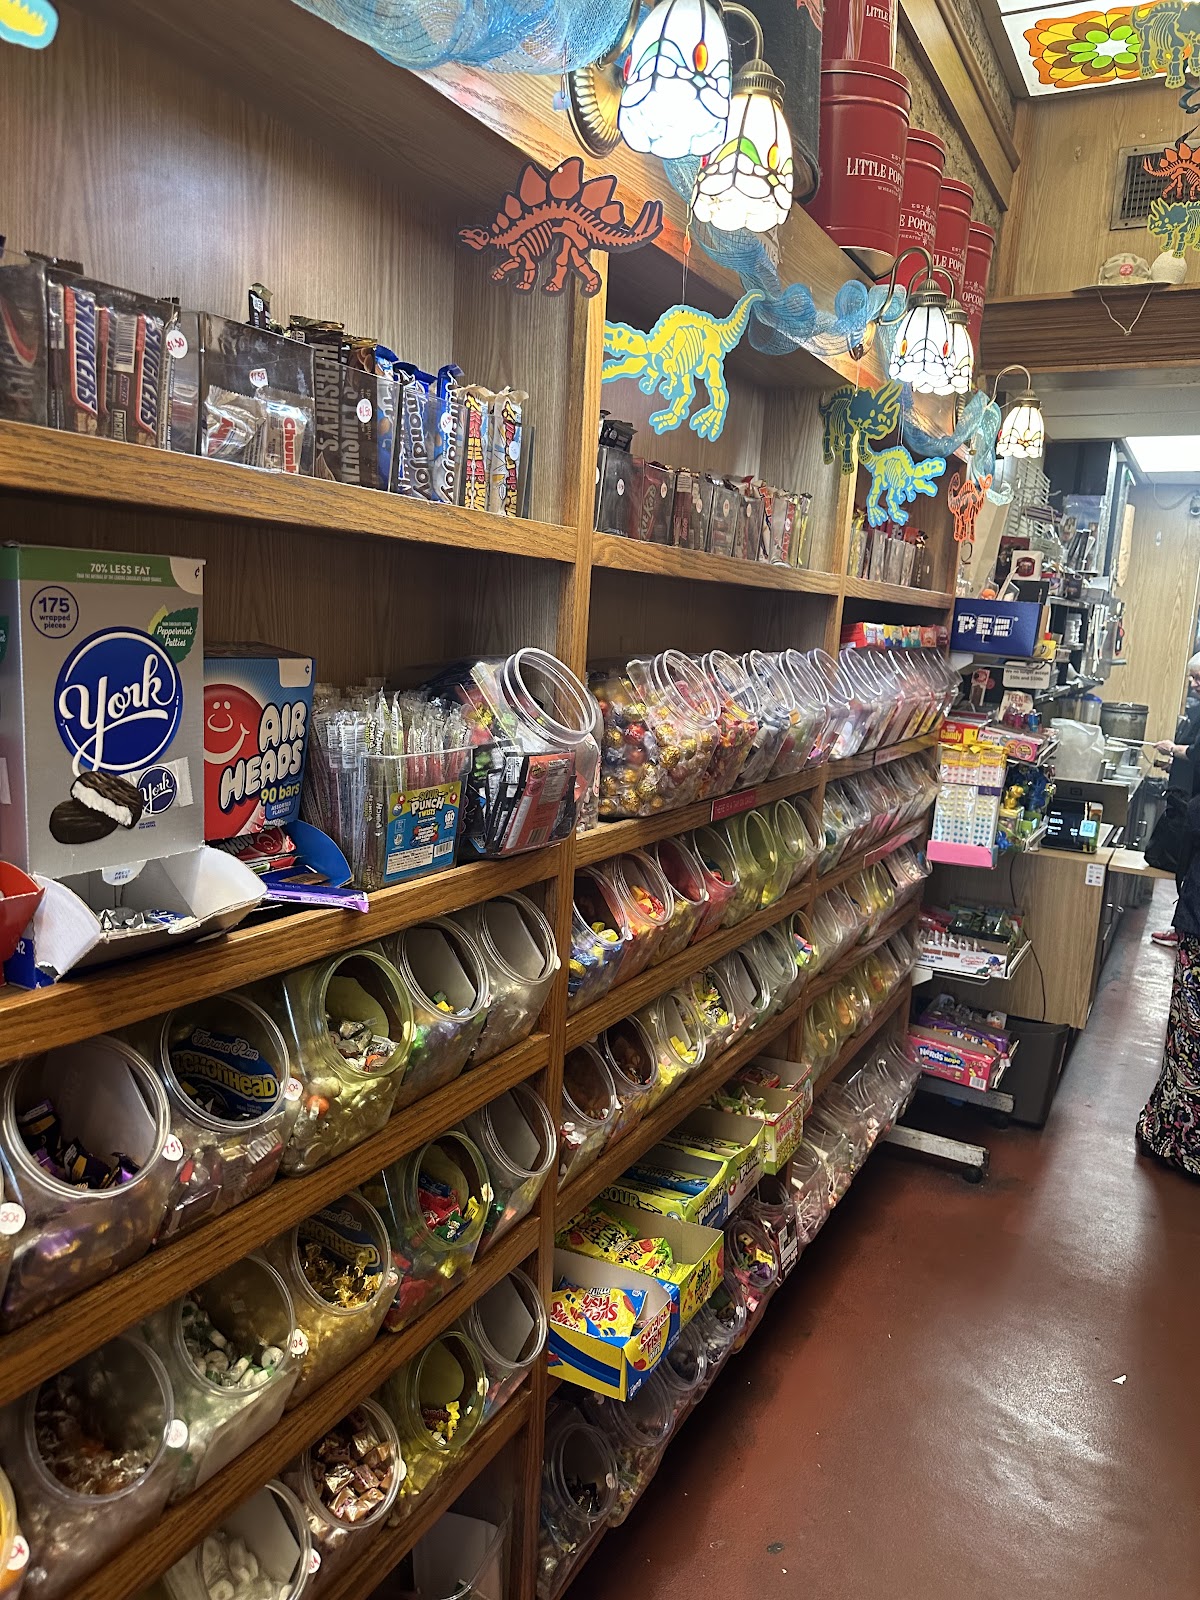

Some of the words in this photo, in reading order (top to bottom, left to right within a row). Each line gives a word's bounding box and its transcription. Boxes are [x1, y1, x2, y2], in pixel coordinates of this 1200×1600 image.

[866, 5, 888, 20] LITTLE
[846, 157, 887, 178] LITTLE
[75, 290, 98, 414] SNICKERS
[140, 318, 164, 435] SNICKERS
[314, 342, 341, 452] HERSHEY'S
[283, 417, 299, 473] Chunk
[90, 563, 108, 573] 70%
[110, 564, 132, 575] LESS
[134, 565, 151, 576] FAT
[38, 597, 70, 613] 175
[39, 614, 71, 624] wrapped
[44, 621, 67, 631] pieces
[957, 612, 1014, 638] PEZ
[156, 625, 194, 639] Peppermint
[164, 637, 186, 647] Patties
[58, 653, 172, 776] York
[259, 700, 308, 753] AIR
[219, 739, 304, 810] HEADS
[139, 773, 174, 813] York
[260, 787, 276, 805] 90
[278, 783, 300, 802] bars
[270, 800, 292, 812] ASSORTED
[271, 806, 290, 817] FLAVORS
[411, 796, 445, 815] PUNCH
[231, 1038, 259, 1060] Pan
[600, 1185, 640, 1209] SOUR
